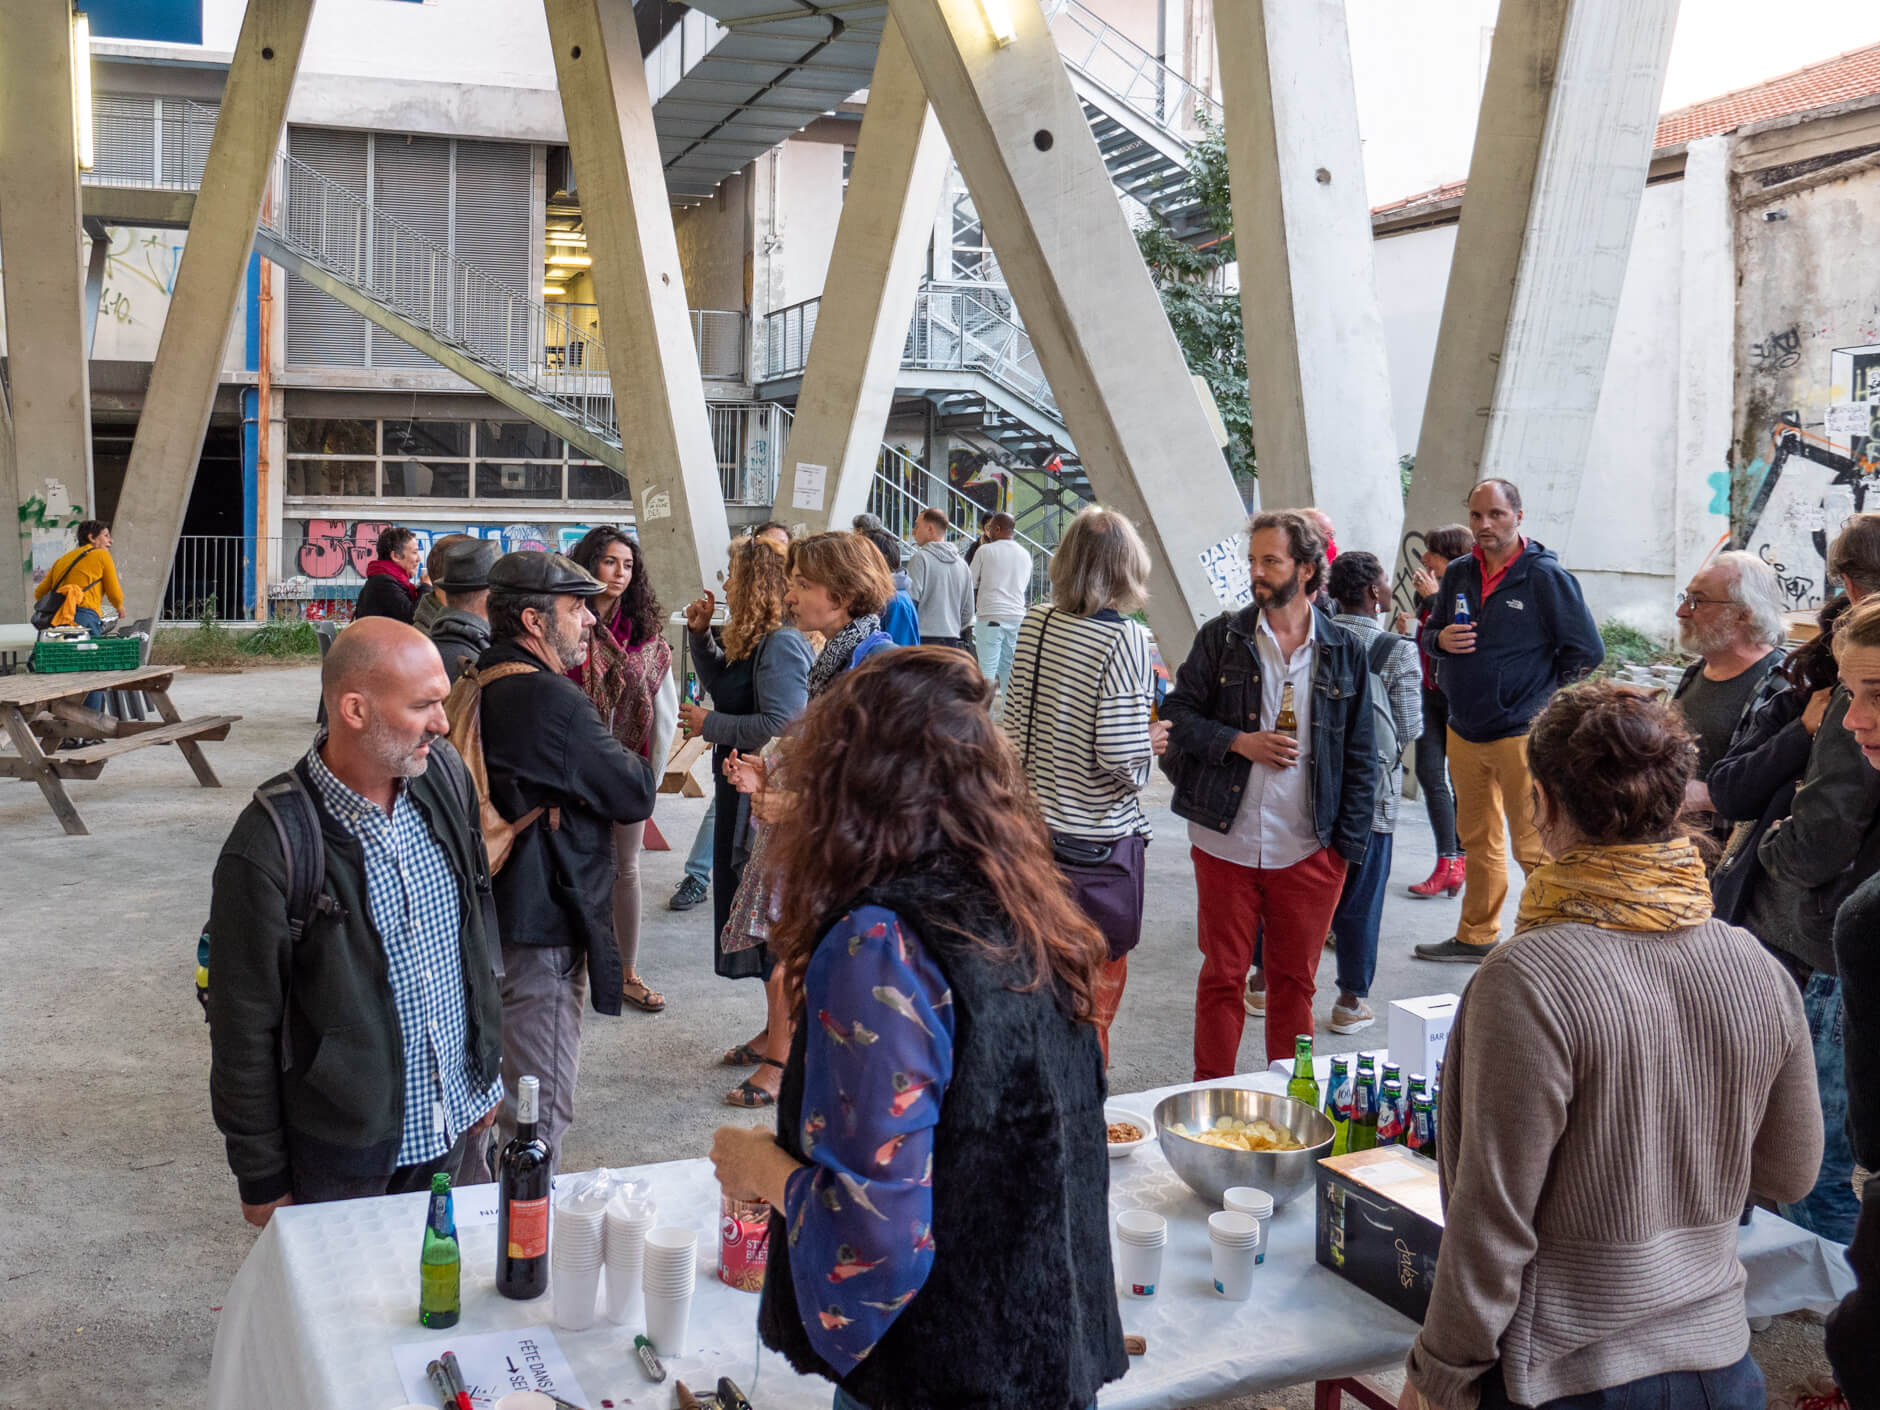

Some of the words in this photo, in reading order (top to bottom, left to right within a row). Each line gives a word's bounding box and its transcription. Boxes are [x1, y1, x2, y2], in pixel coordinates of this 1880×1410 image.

[1430, 1032, 1445, 1041] BAR
[518, 1339, 541, 1364] FÊTE
[529, 1363, 553, 1389] DANS
